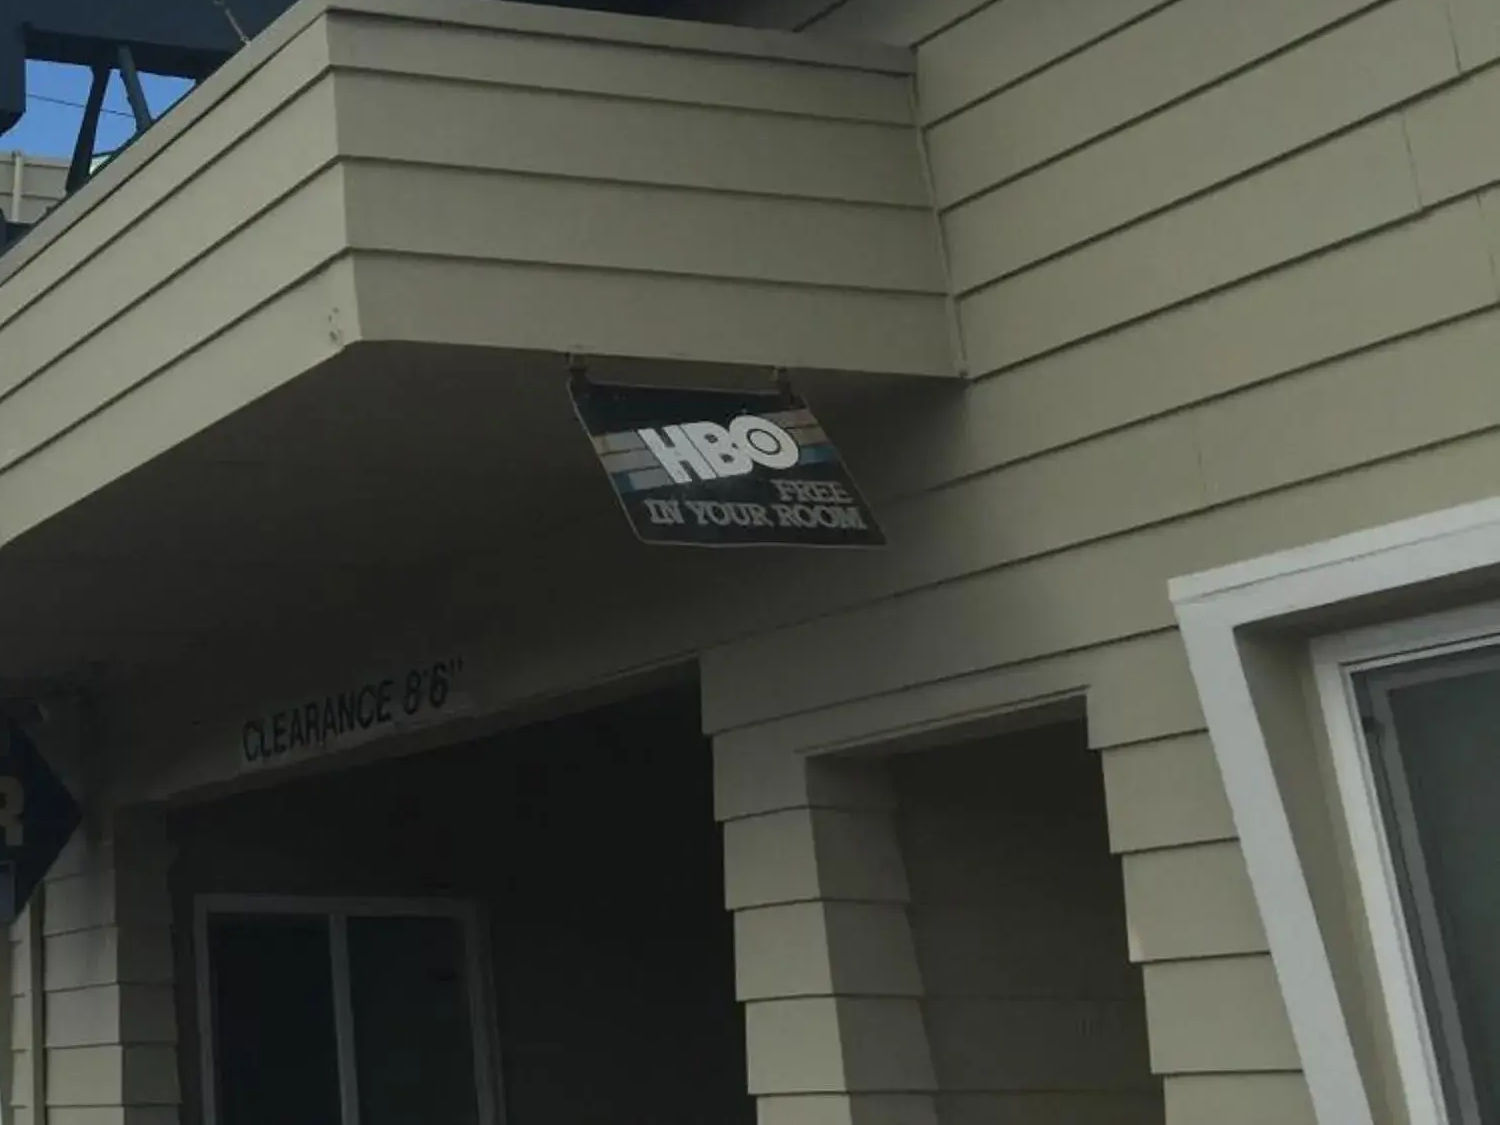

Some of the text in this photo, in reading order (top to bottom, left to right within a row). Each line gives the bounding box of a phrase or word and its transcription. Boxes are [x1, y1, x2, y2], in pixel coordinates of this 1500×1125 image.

[636, 414, 800, 484] HBO
[645, 498, 869, 531] IN YOUR ROOM
[772, 478, 854, 504] FREE
[242, 678, 394, 762] CLEARANCE
